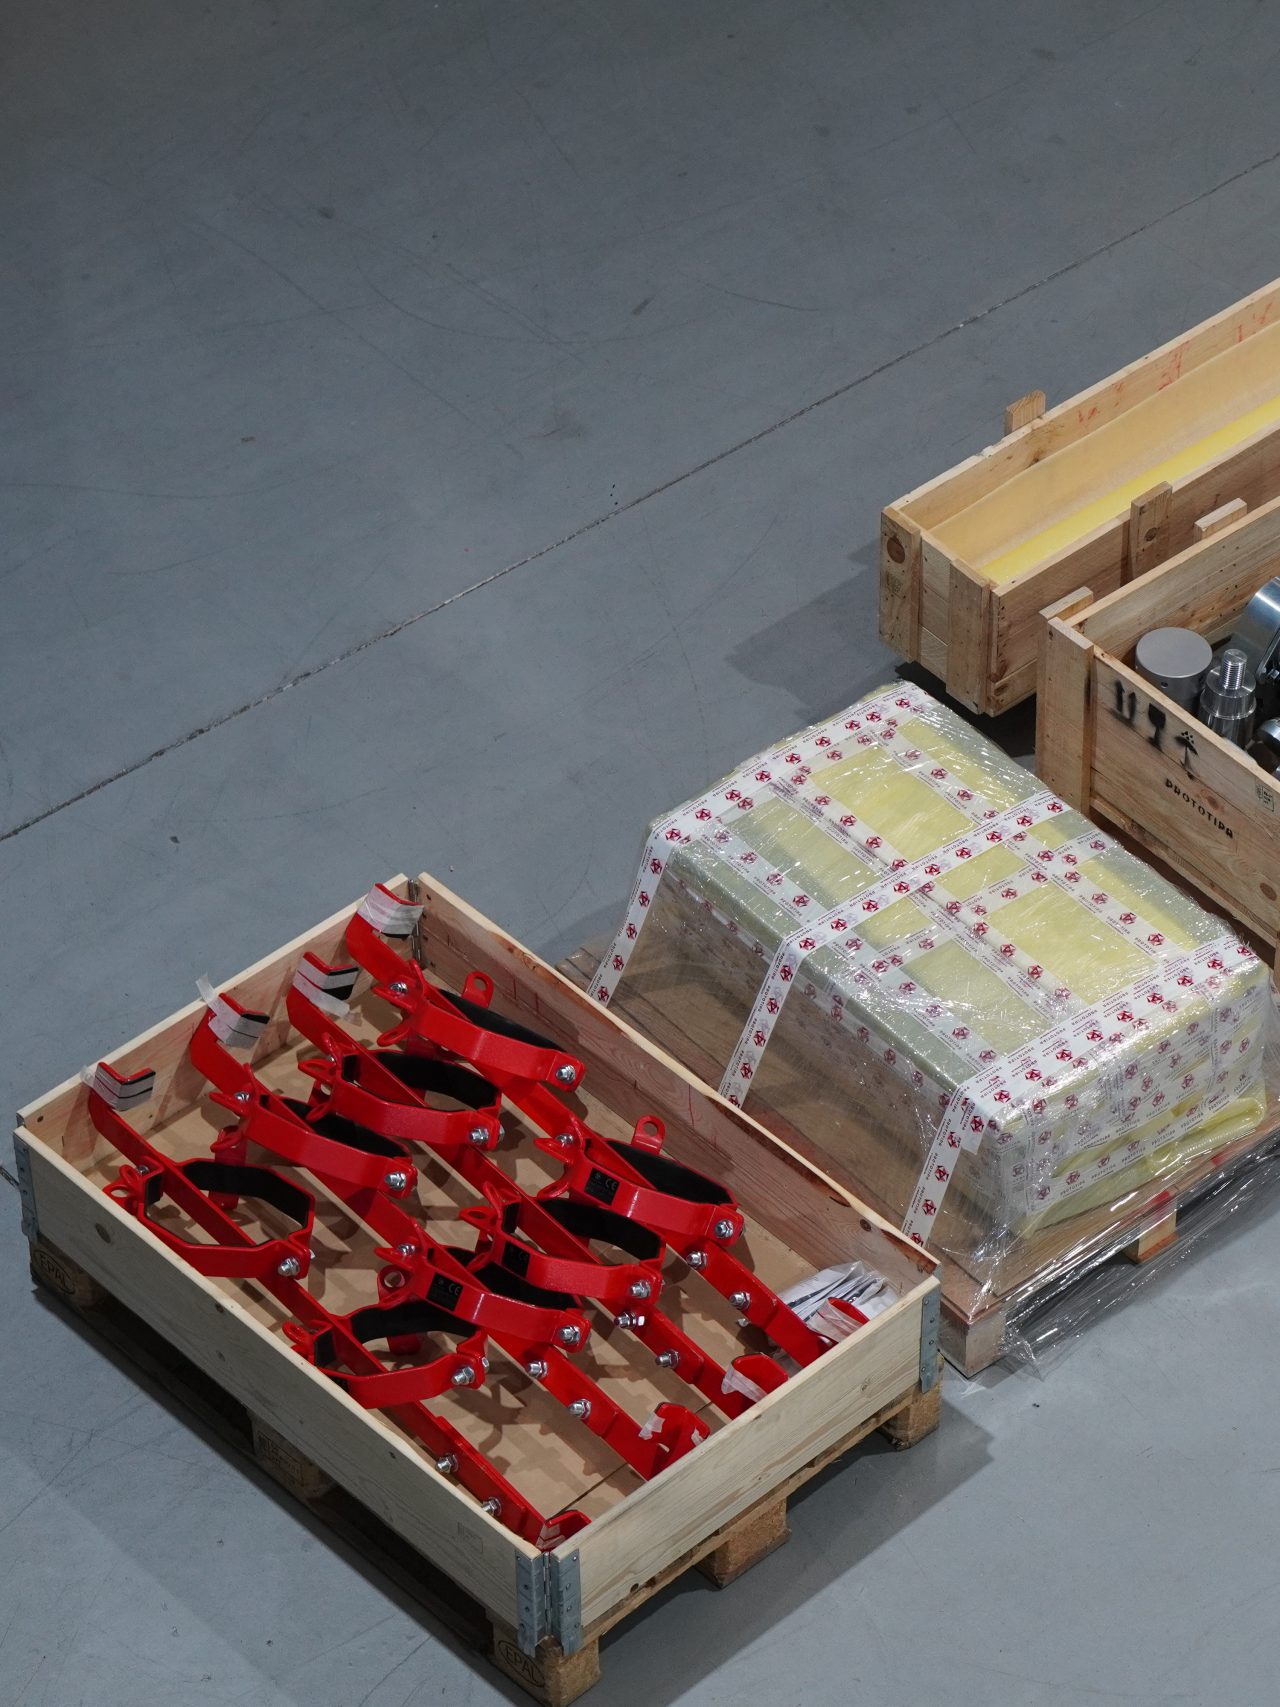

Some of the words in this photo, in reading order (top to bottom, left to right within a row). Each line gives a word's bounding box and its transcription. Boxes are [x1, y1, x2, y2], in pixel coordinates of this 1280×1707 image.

[1165, 778, 1234, 838] PROTOTIPA
[41, 1253, 70, 1291] EPAL
[505, 1645, 540, 1684] EPAL
